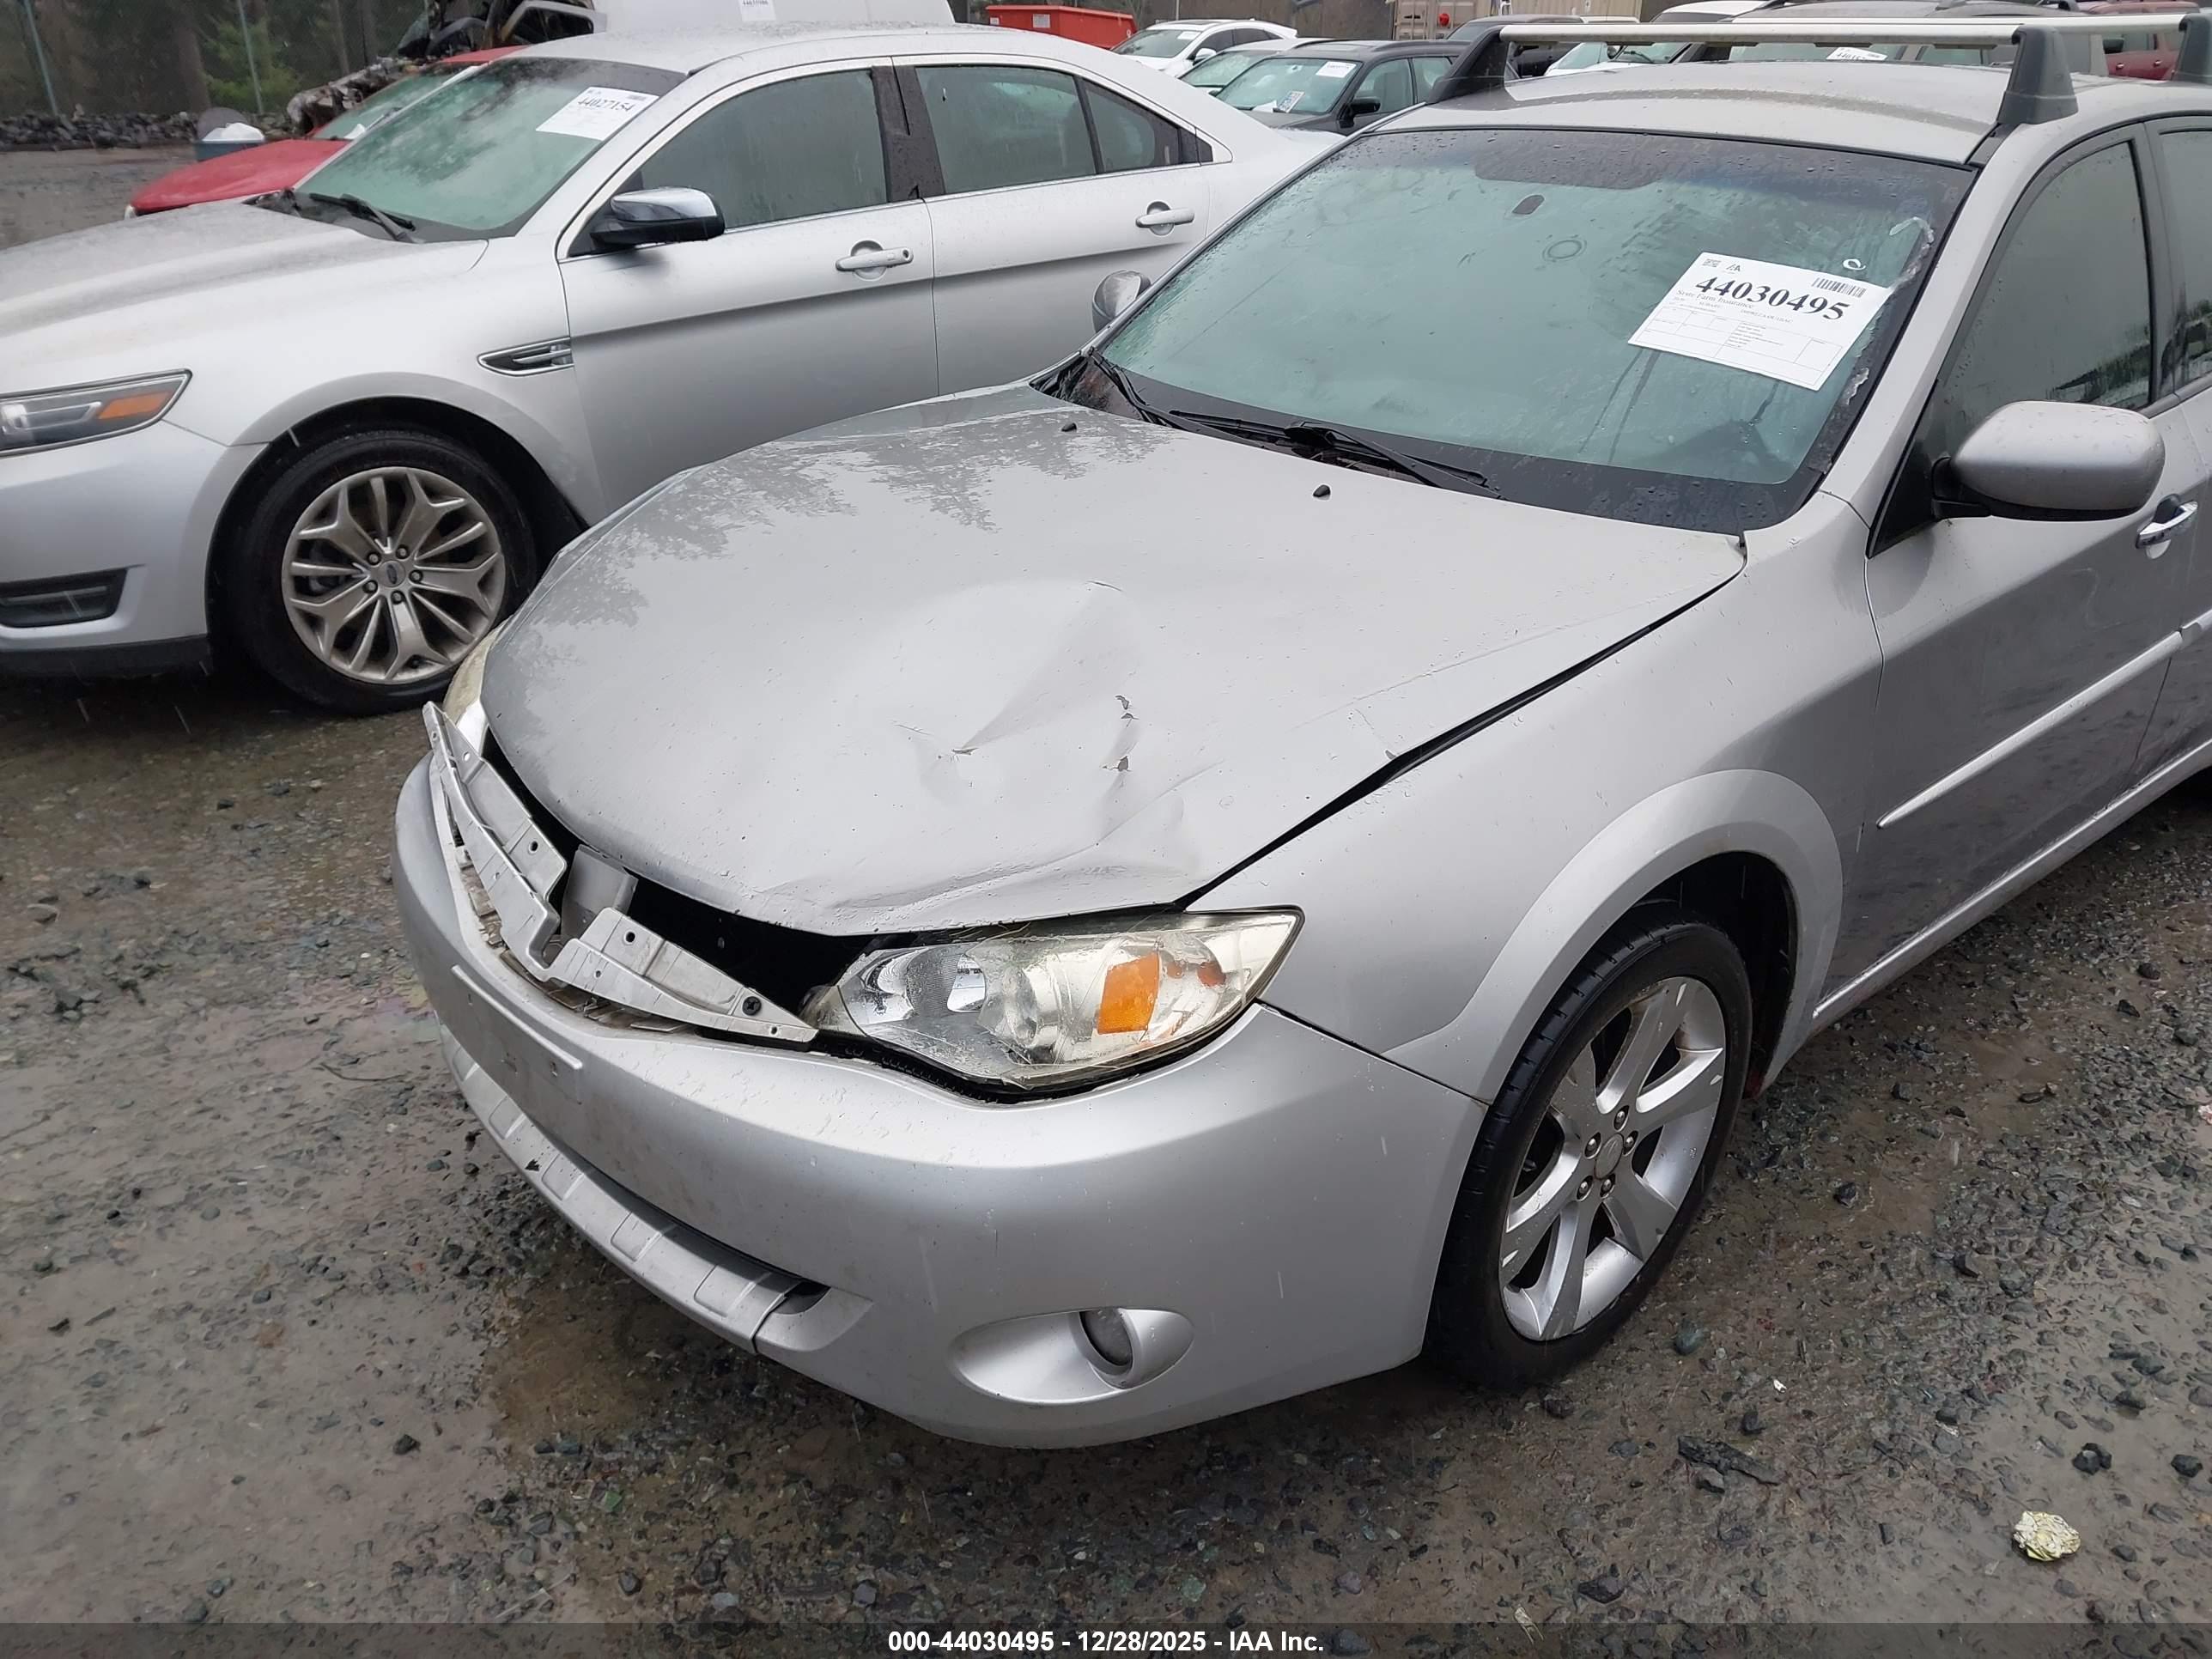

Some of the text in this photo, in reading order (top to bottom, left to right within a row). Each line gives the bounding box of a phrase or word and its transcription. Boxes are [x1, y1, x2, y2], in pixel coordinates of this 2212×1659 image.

[578, 96, 635, 112] 44027154
[1695, 276, 1850, 320] 44030495
[1697, 293, 1717, 302] Farm
[1717, 296, 1754, 309] Insurance
